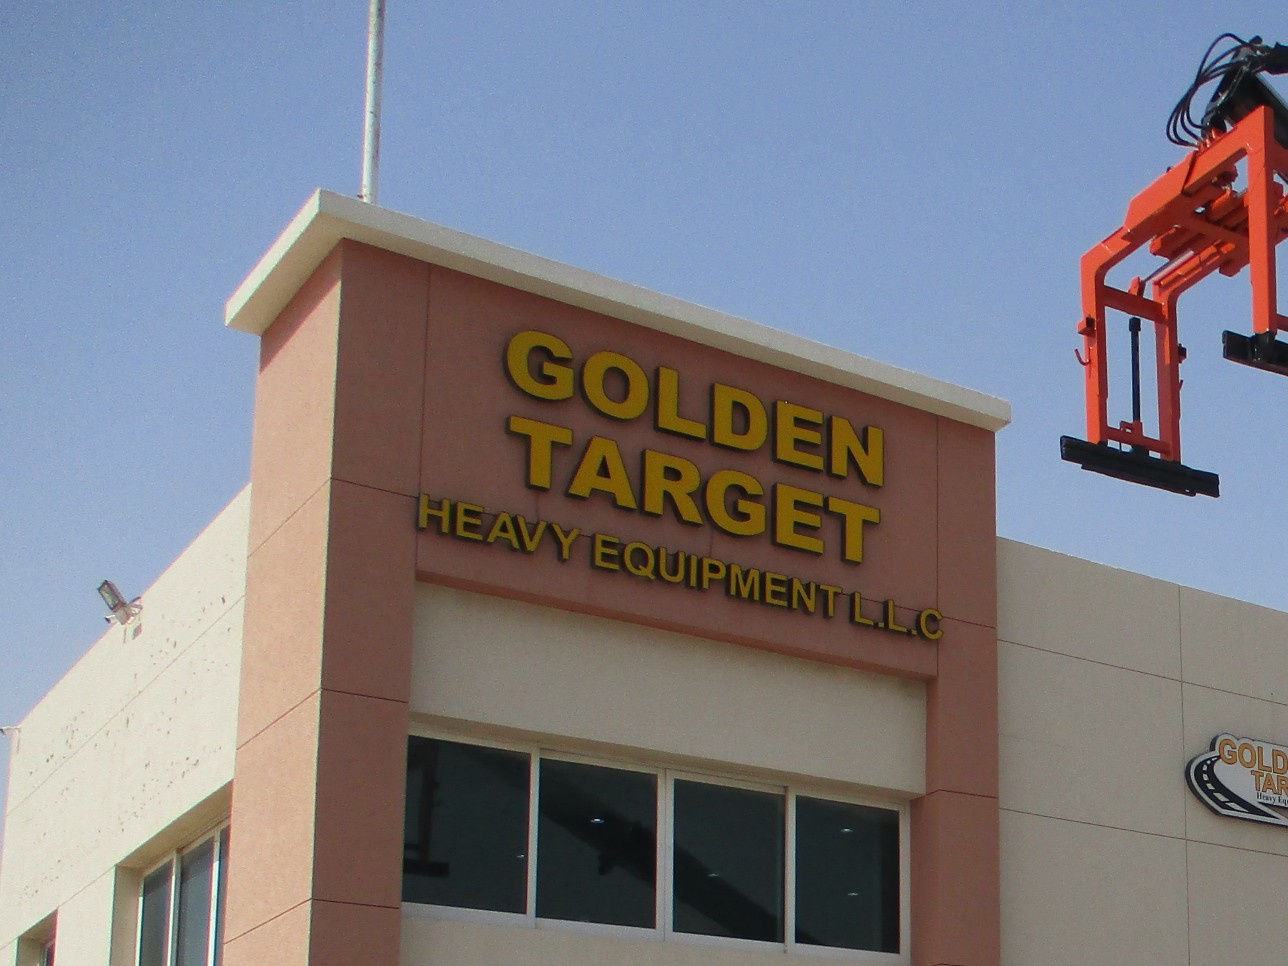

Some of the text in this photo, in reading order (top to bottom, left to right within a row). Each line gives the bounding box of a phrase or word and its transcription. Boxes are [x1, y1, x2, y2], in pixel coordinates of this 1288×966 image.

[504, 330, 885, 488] GOLDEN
[506, 416, 881, 564] TARGET
[417, 493, 944, 642] HEAVY EQUIPMENT L.L.C
[1256, 791, 1277, 804] Heavy
